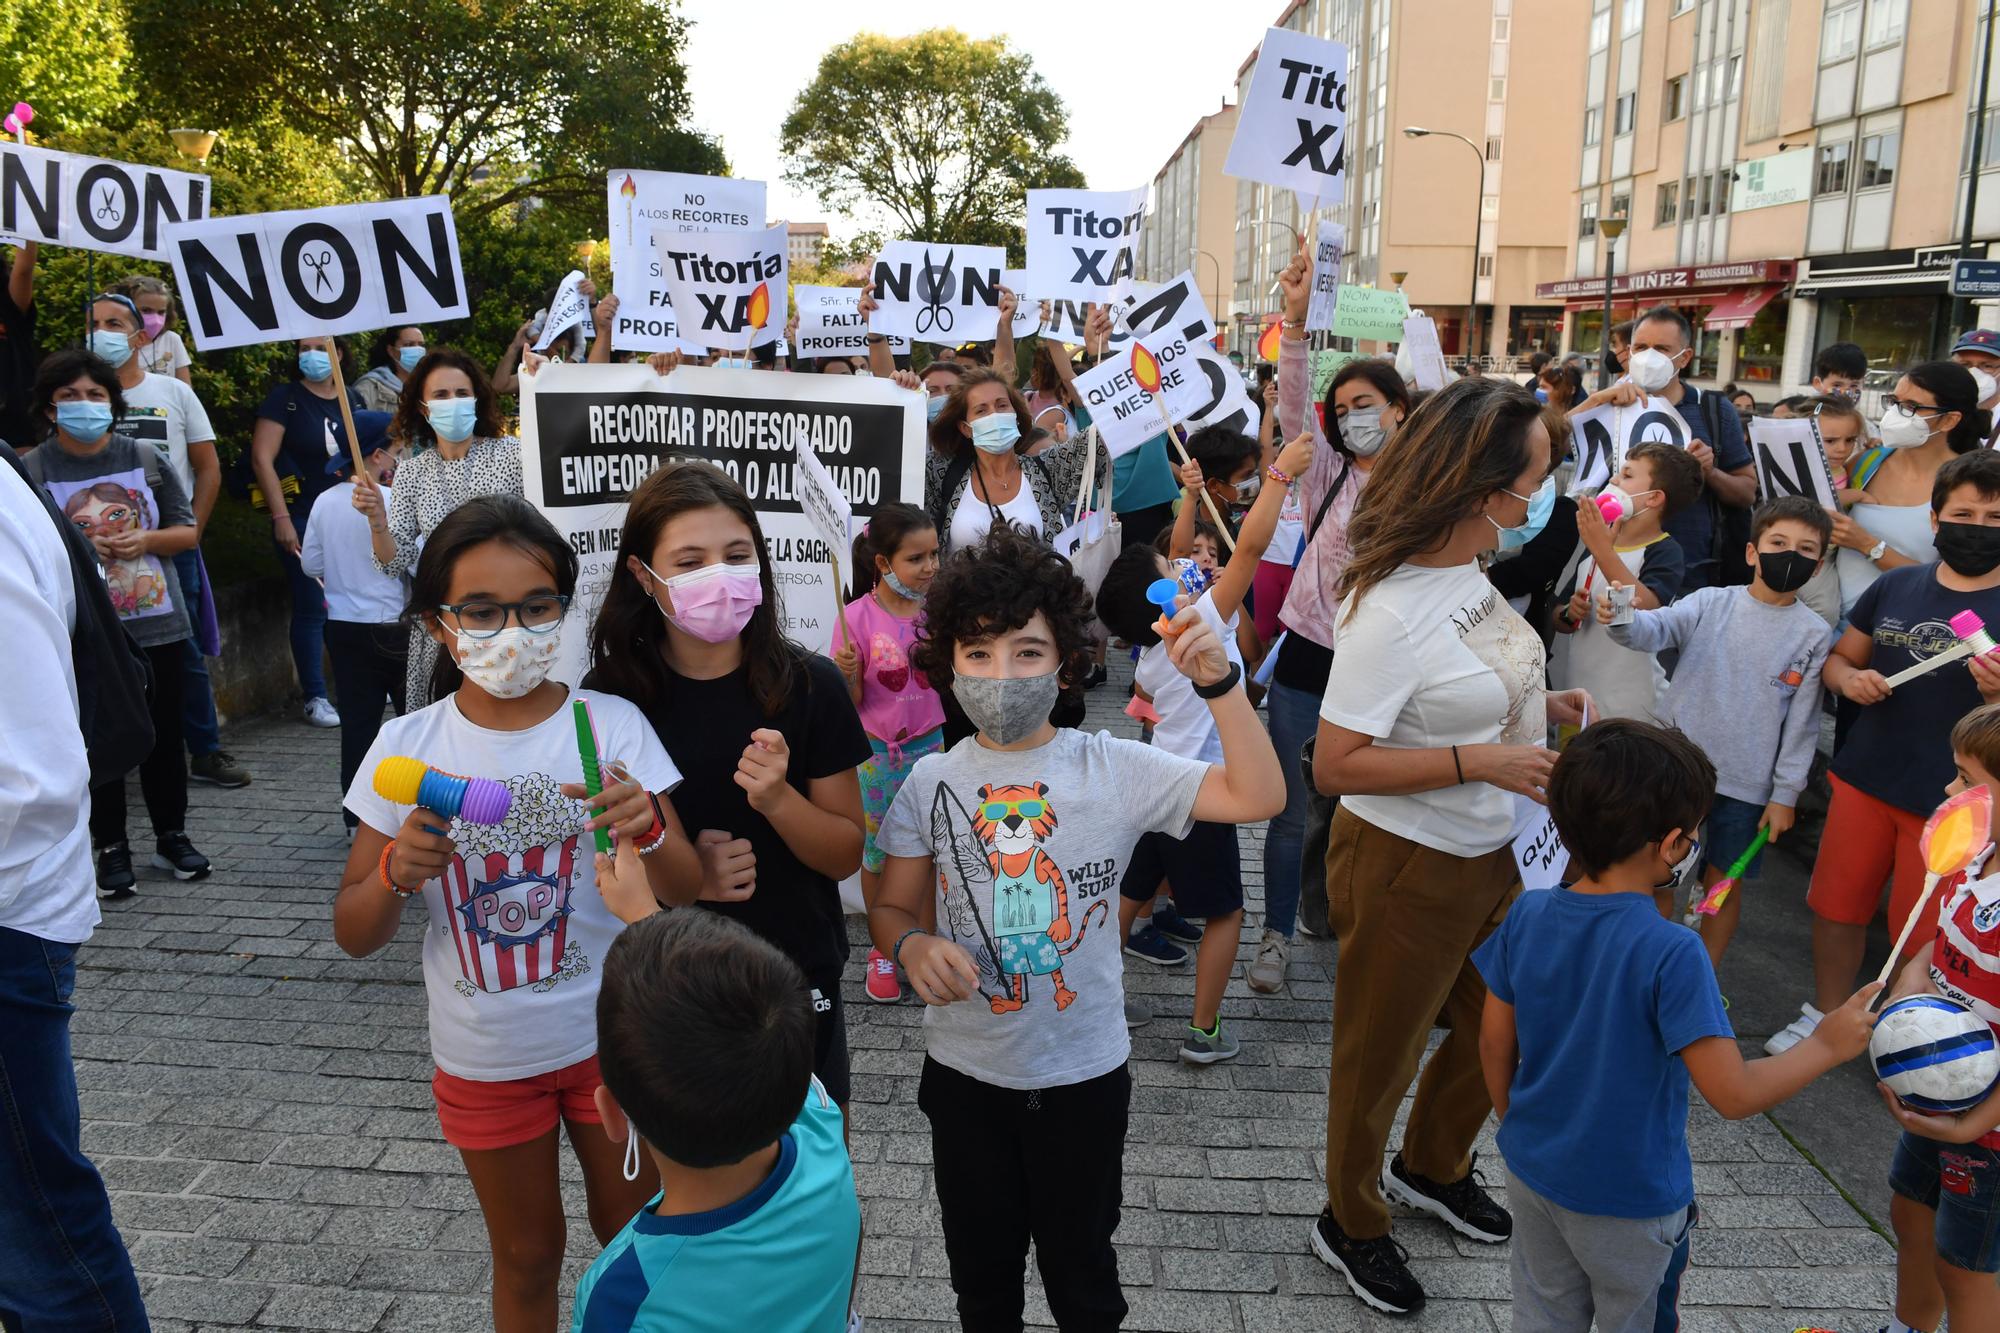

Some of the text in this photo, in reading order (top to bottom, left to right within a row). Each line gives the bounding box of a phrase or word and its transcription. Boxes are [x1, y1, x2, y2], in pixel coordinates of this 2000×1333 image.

[3, 152, 204, 251] NON
[684, 193, 705, 206] NO
[638, 208, 749, 226] A LOS RECORTES
[177, 211, 459, 339] NON
[667, 250, 782, 284] Titoría
[1070, 246, 1134, 286] XA
[1628, 271, 1688, 290] NUÑEZ
[1695, 264, 1755, 279] CROISSANTERIA
[1113, 368, 1185, 420] MESRE
[589, 404, 695, 447] RECORTAR
[746, 461, 760, 500] O
[798, 453, 847, 538] QUEREMOS
[776, 538, 792, 562] LA
[582, 563, 599, 577] AS
[800, 617, 819, 629] NA
[1067, 858, 1116, 884] WILD
[1078, 872, 1119, 900] SURF
[474, 876, 567, 933] POP!
